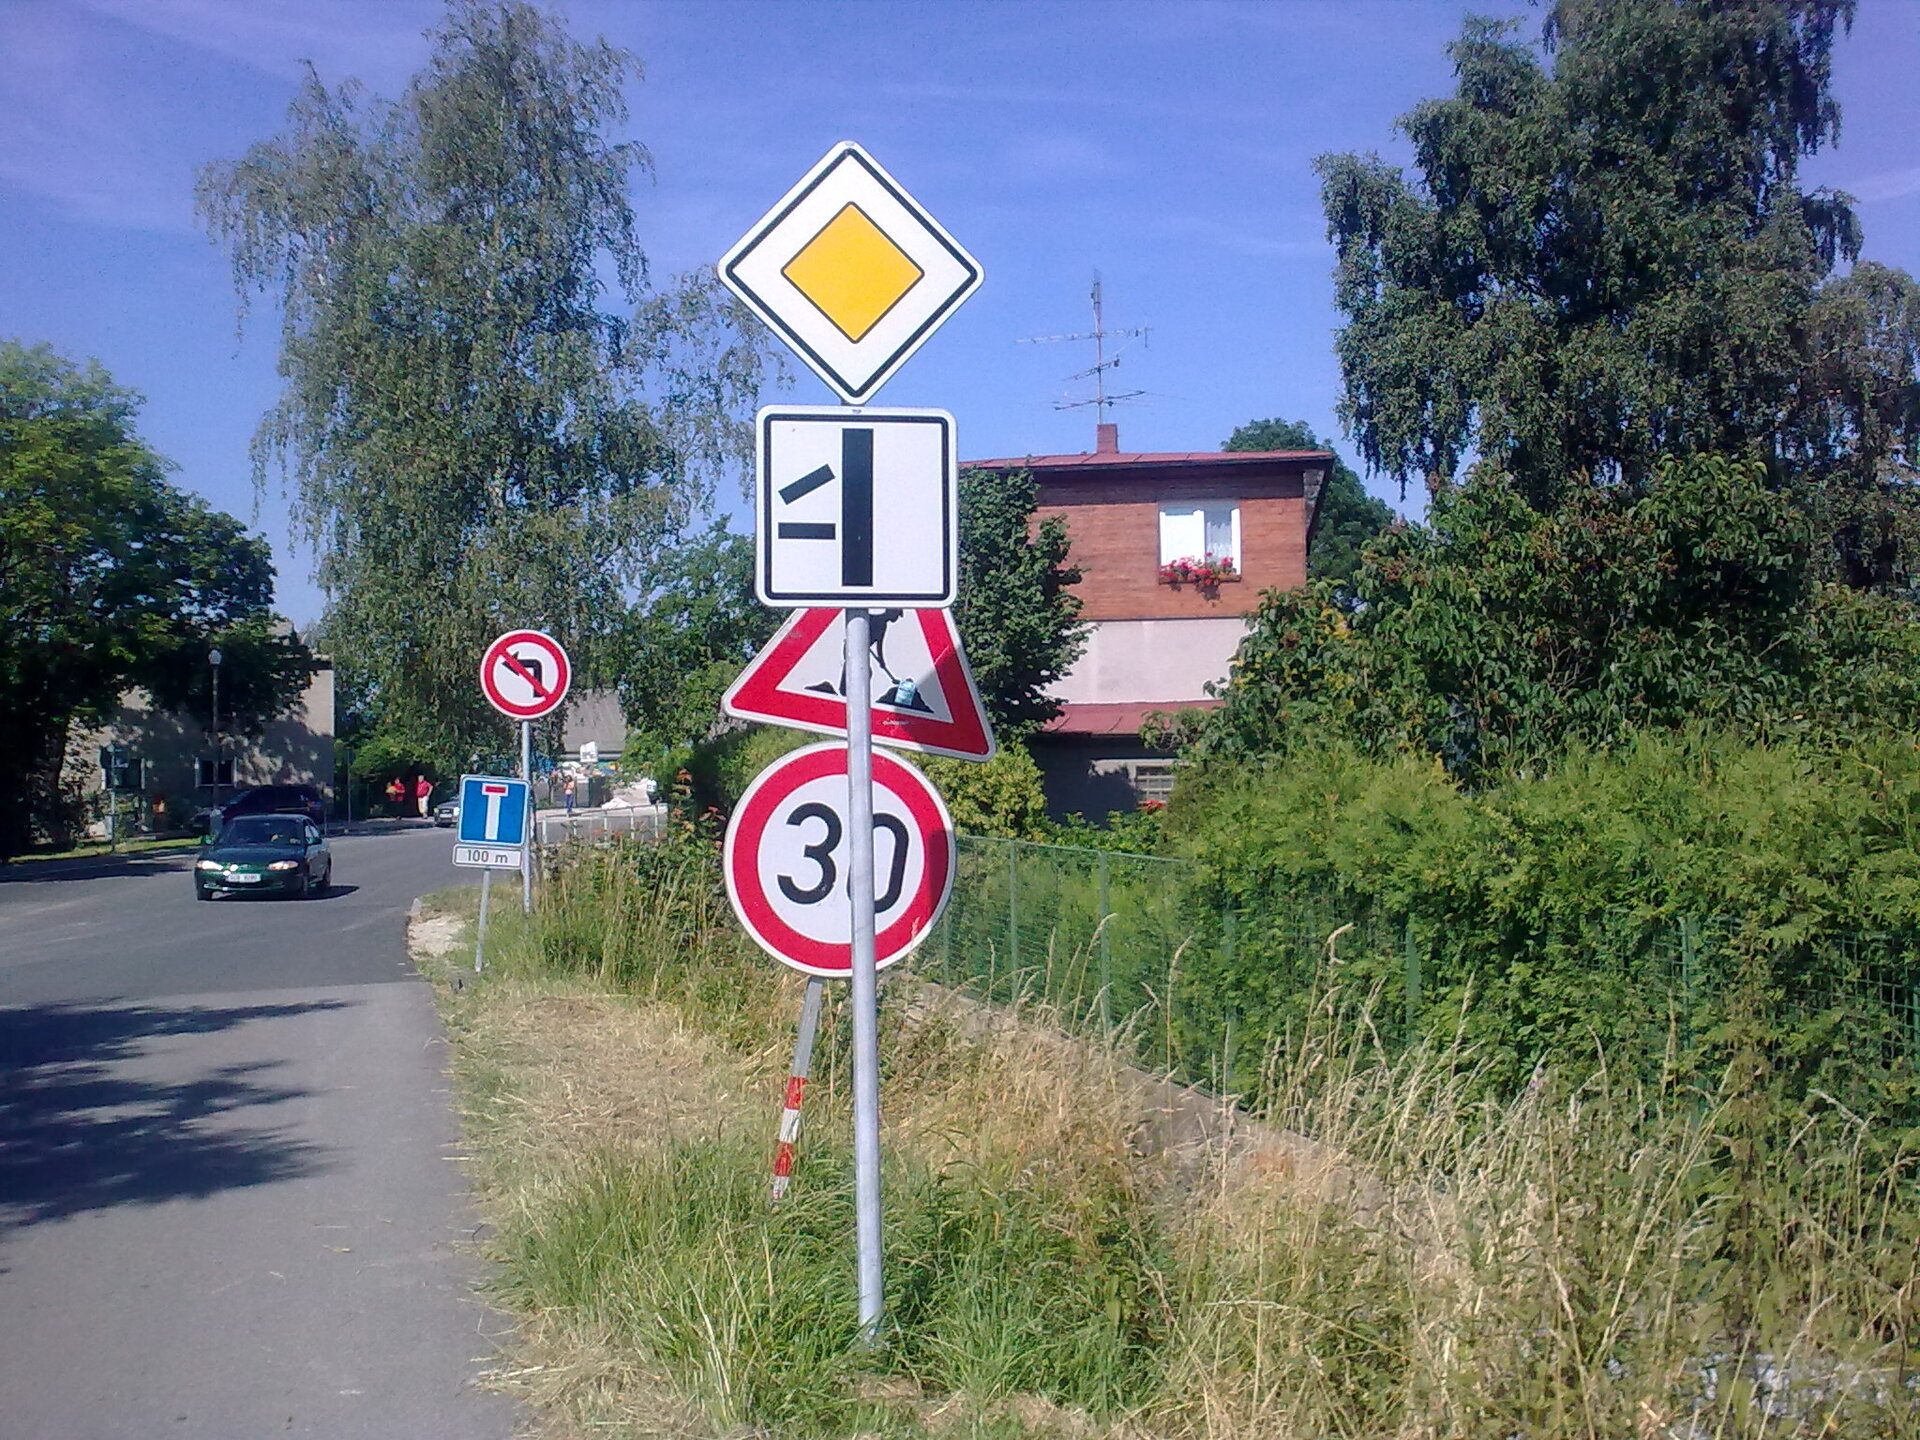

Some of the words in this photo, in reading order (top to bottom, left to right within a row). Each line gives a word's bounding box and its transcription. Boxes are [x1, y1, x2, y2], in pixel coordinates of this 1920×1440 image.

[467, 849, 490, 862] 100
[494, 854, 509, 864] m
[777, 802, 910, 914] 30
